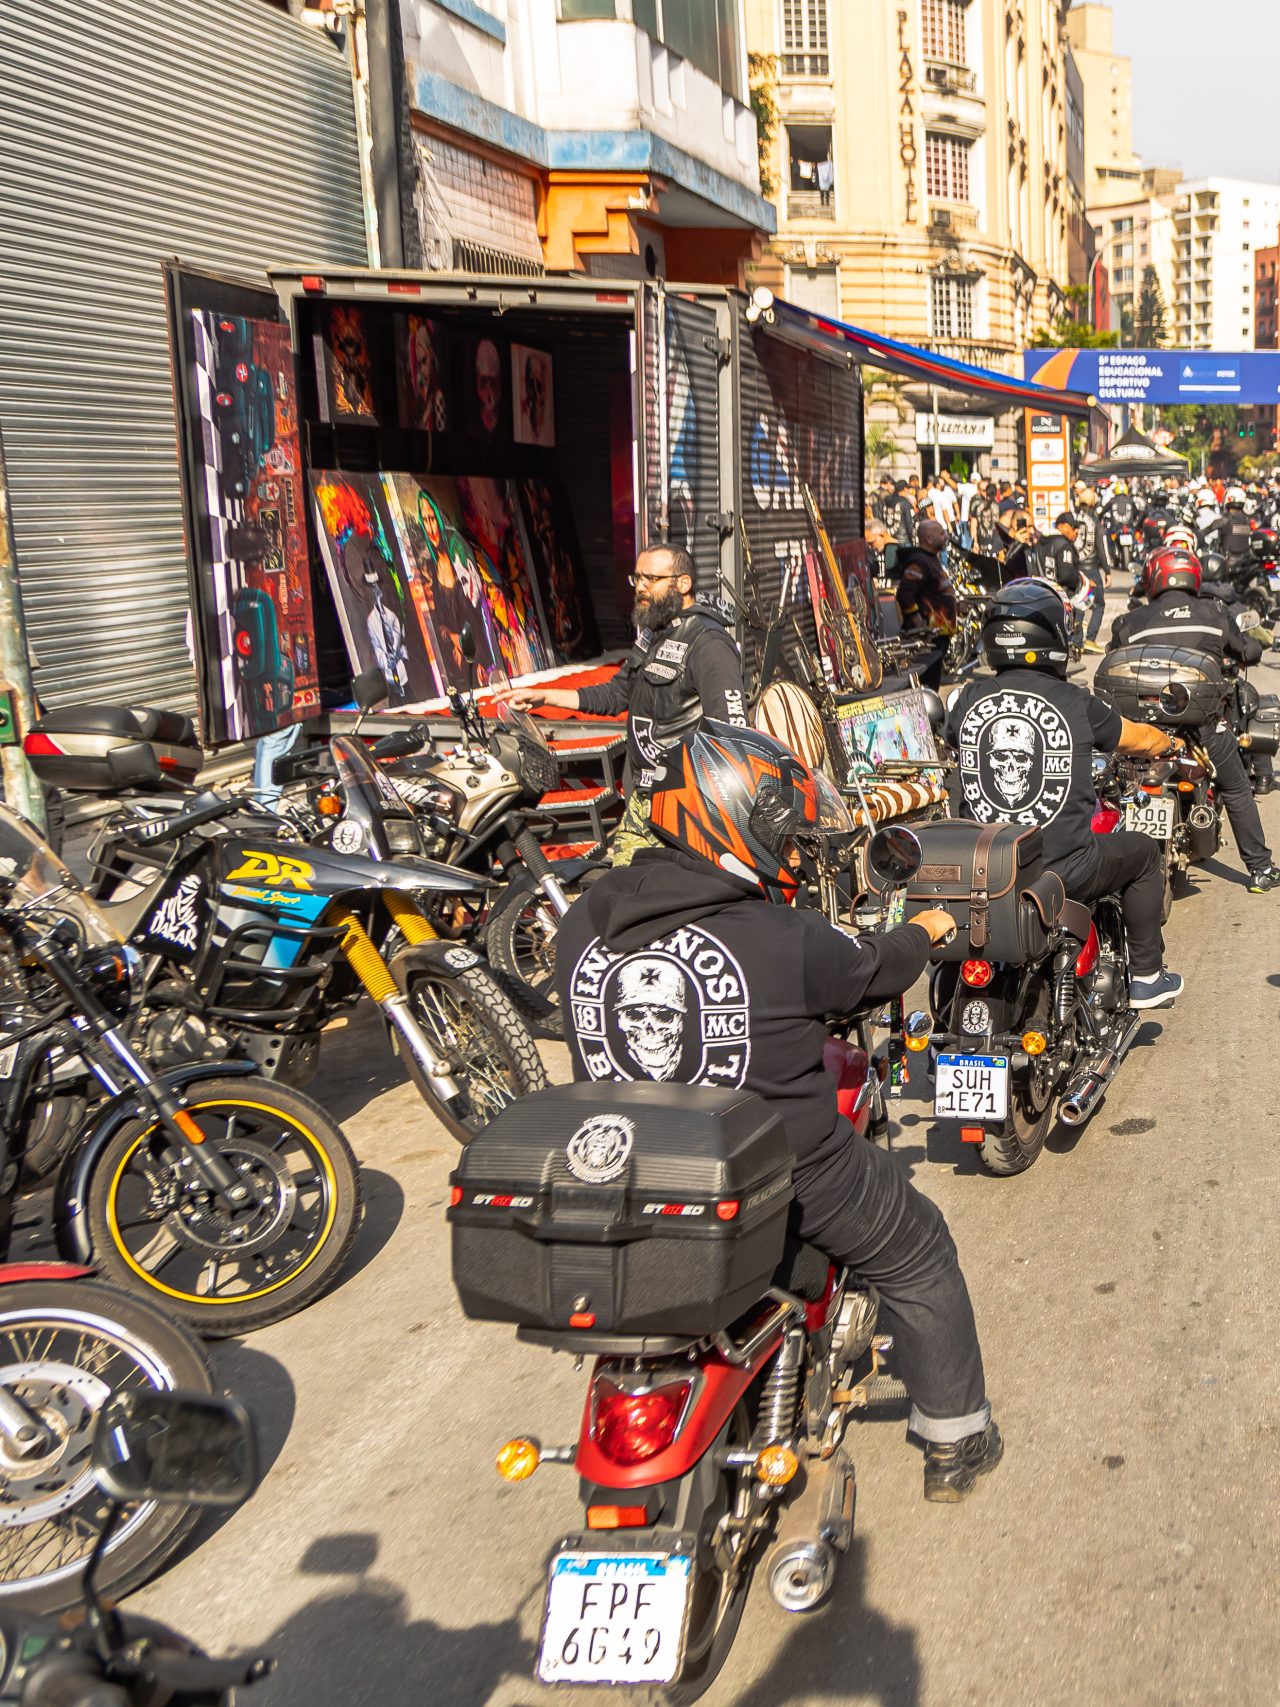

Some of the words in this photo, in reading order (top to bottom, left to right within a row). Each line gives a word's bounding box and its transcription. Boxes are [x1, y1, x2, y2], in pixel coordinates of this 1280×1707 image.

[1098, 366, 1163, 377] EDUCACIONAL
[1098, 377, 1150, 388] ESPORTIVO
[1098, 388, 1147, 398] CULTURAL
[961, 694, 1069, 749] INSANOS
[961, 751, 976, 768] 18
[1045, 756, 1070, 773] MC
[964, 781, 1065, 827] BRASIL
[1130, 821, 1167, 836] 7225
[226, 850, 314, 890] DR
[150, 912, 198, 951] DAKAR
[576, 929, 741, 1003] INNOS
[576, 1006, 598, 1030] 18
[705, 1014, 746, 1037] MC
[959, 1059, 986, 1067] BRASIL
[952, 1069, 991, 1090] SUH
[937, 1105, 946, 1113] BR
[945, 1091, 997, 1113] 1E71
[579, 1582, 657, 1620] FPF
